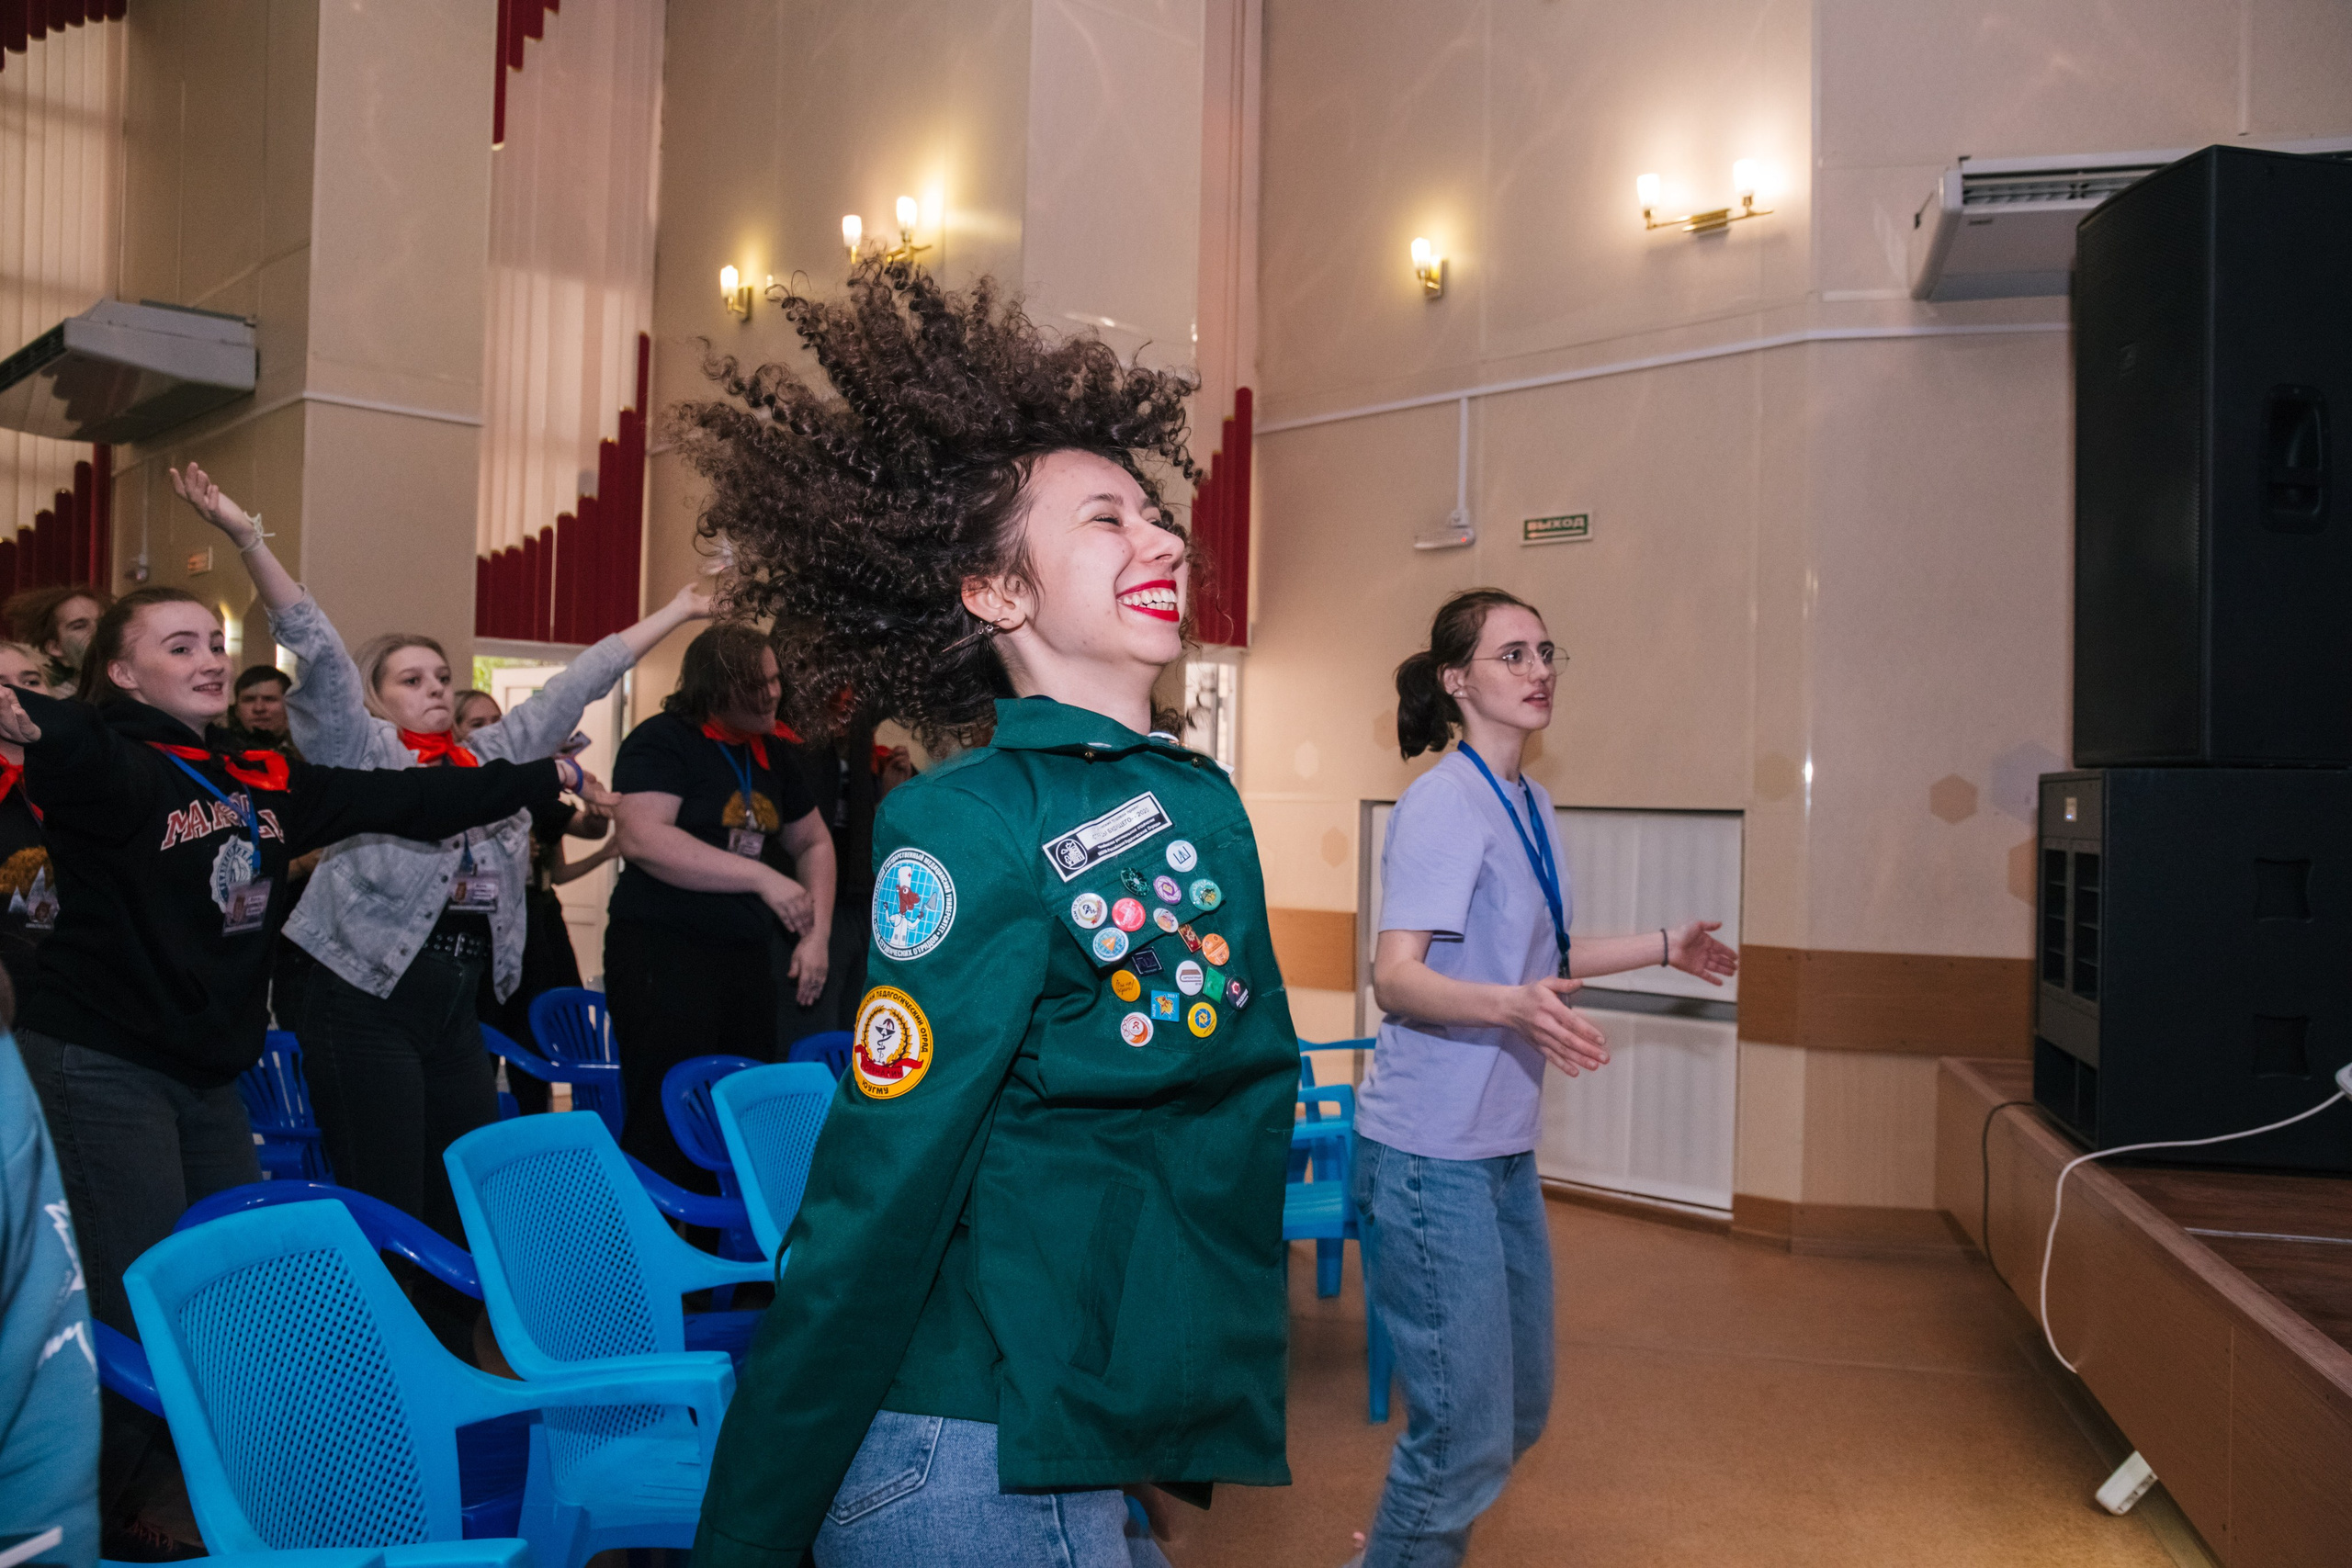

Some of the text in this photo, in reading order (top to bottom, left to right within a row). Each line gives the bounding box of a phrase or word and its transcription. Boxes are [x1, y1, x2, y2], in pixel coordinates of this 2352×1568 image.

[1527, 516, 1585, 531] ВЫХОД
[876, 989, 924, 1027] ПЕДАГОГИЧЕСКИЙ
[920, 1027, 929, 1054] ОТРЯД
[862, 1079, 889, 1095] ЮУГМУ
